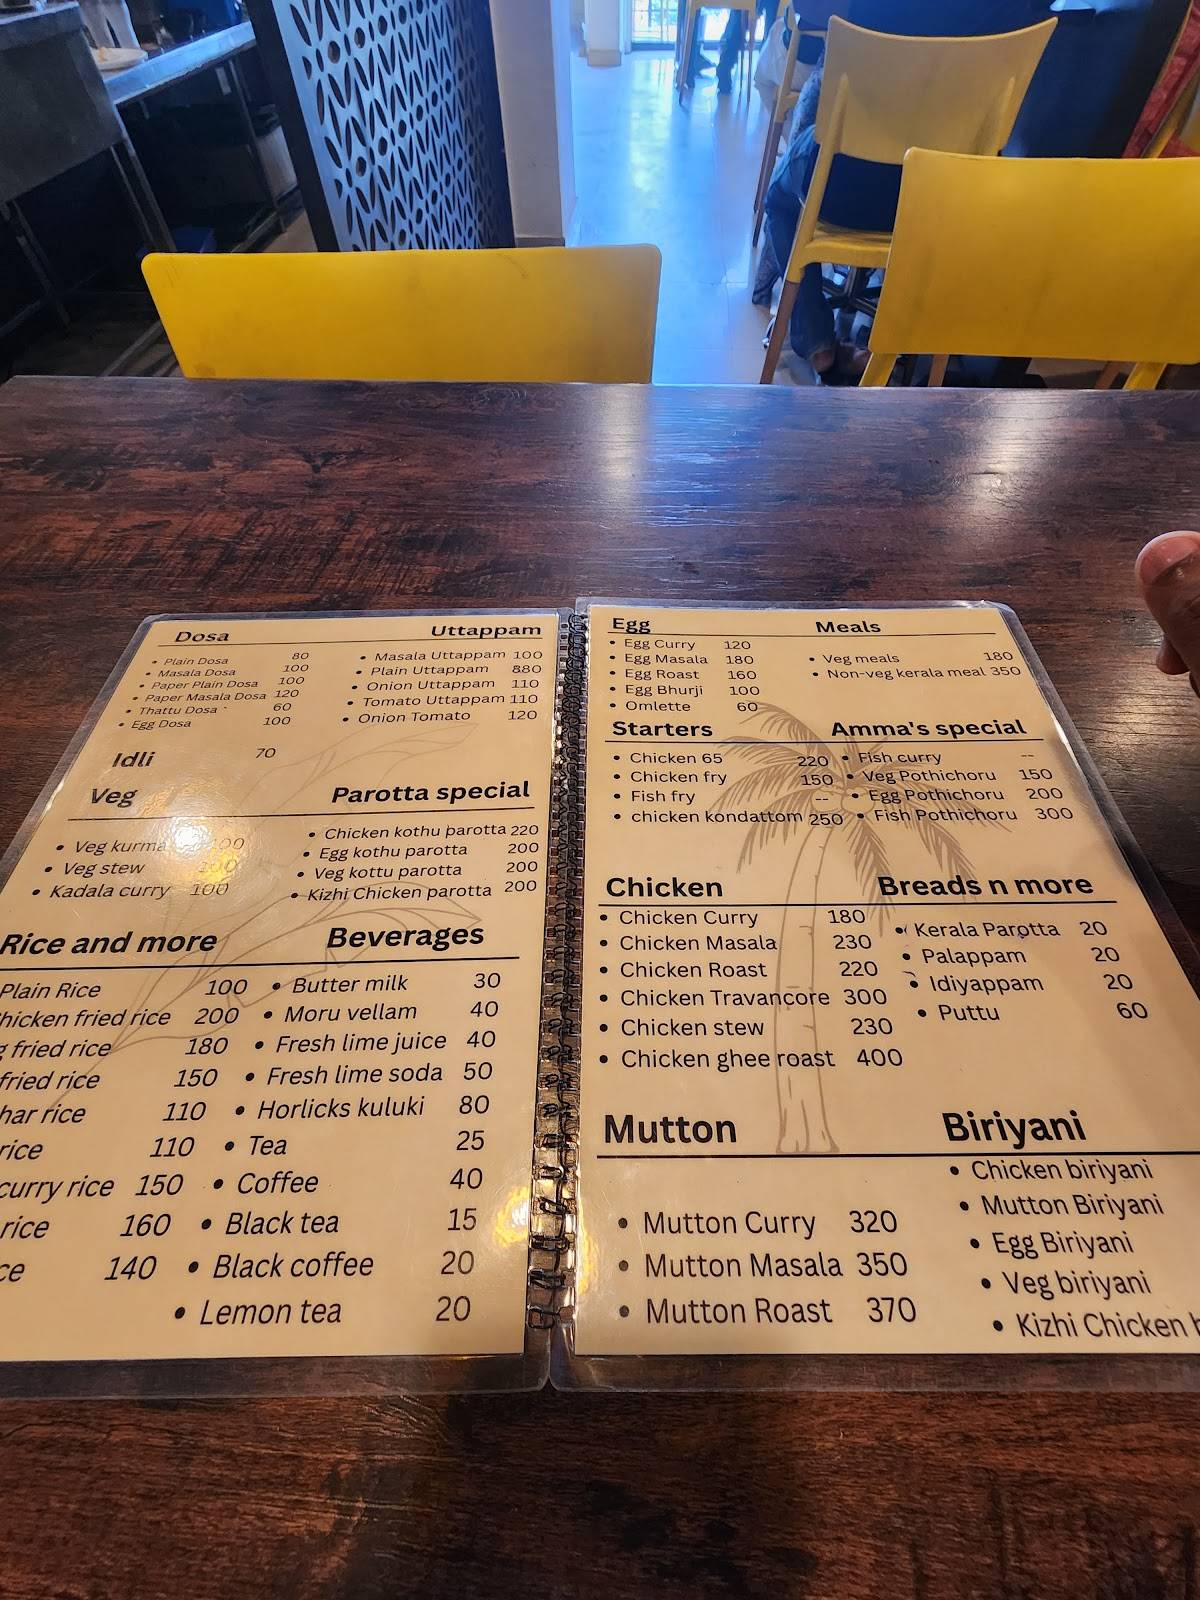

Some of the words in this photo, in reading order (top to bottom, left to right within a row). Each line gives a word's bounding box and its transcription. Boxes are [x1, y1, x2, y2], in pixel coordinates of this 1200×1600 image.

[432, 626, 541, 639] Uttappam
[612, 616, 652, 634] Egg
[816, 621, 881, 633] Meals
[175, 632, 229, 642] Dosa
[654, 640, 695, 651] Curry
[724, 641, 751, 649] 120
[855, 654, 900, 663] meals
[158, 669, 201, 677] Masala
[512, 665, 542, 673] 880
[657, 670, 699, 679] Roast
[728, 670, 756, 680] 160
[827, 670, 894, 680] Non-veg
[896, 668, 944, 678] kerala
[947, 667, 986, 677] meal
[990, 666, 1021, 675] 350
[151, 682, 190, 691] Paper
[367, 682, 412, 691] Onion
[512, 680, 539, 688] 110
[658, 685, 703, 698] Bhurji
[729, 686, 760, 695] 100
[145, 695, 183, 704] Paper
[276, 689, 299, 698] 120
[363, 697, 421, 706] Tomato
[427, 696, 504, 706] Uttappam
[140, 707, 181, 715] Thattu
[273, 703, 291, 711] 60
[626, 701, 690, 711] Omlette
[131, 721, 156, 730] Egg
[158, 720, 191, 728] Dosa
[358, 714, 405, 723] Onion
[414, 712, 470, 722] Tomato
[613, 721, 712, 736] Starters
[832, 722, 930, 736] Amma's
[936, 719, 1027, 739] special
[112, 752, 155, 767] Idli
[256, 748, 276, 758] 70
[702, 753, 722, 764] 65
[897, 754, 941, 765] curry
[704, 771, 727, 785] fry
[899, 770, 996, 781] Pothichoru
[1019, 769, 1052, 780] 150
[92, 788, 138, 808] Veg
[332, 786, 429, 803] Parotta
[436, 781, 530, 804] special
[632, 790, 665, 802] Fish
[671, 790, 695, 805] fry
[1026, 788, 1063, 799] 200
[632, 810, 699, 822] chicken
[705, 810, 802, 823] kondattom
[809, 813, 843, 825] 250
[874, 809, 911, 821] Fish
[915, 808, 1018, 821] Pothichoru
[1035, 808, 1073, 820] 300
[325, 827, 389, 839] Chicken
[394, 826, 440, 837] kothu
[445, 825, 506, 839] parotta
[511, 825, 538, 836] 220
[108, 838, 167, 853] kurma
[353, 846, 400, 858] kothu
[508, 842, 539, 854] 200
[99, 863, 145, 874] stew
[349, 866, 393, 878] kottu
[50, 884, 114, 898] Kadala
[119, 886, 171, 900] curry
[308, 888, 349, 901] Kizhi
[427, 885, 491, 901] parotta
[606, 877, 723, 897] Chicken
[877, 875, 982, 896] Breads
[988, 880, 1008, 895] n
[1014, 879, 1093, 894] more
[828, 910, 865, 923] 180
[327, 927, 484, 951] Beverages
[914, 922, 979, 937] Kerala
[982, 922, 1061, 939] Parotta
[0, 933, 66, 955] Rice
[71, 931, 133, 954] and
[136, 935, 217, 952] more
[833, 935, 871, 949] 230
[922, 948, 1026, 967] Palappam
[839, 961, 878, 976] 220
[0, 983, 51, 999] Plain
[56, 982, 101, 998] Rice
[293, 978, 360, 993] Butter
[365, 975, 408, 991] milk
[474, 973, 500, 988] 30
[930, 975, 1044, 996] Idiyappam
[1103, 974, 1133, 990] 20
[710, 990, 830, 1006] Travancore
[844, 989, 887, 1005] 300
[0, 1011, 69, 1028] hicken
[74, 1009, 127, 1026] fried
[130, 1009, 171, 1026] rice
[284, 1006, 340, 1022] Moru
[348, 1003, 417, 1020] vellam
[470, 1001, 498, 1017] 40
[938, 1004, 1000, 1021] Puttu
[1117, 1002, 1148, 1019] 60
[714, 1020, 764, 1036] stew
[851, 1018, 892, 1035] 230
[185, 1037, 228, 1055] 180
[276, 1034, 335, 1053] Fresh
[343, 1034, 388, 1051] lime
[391, 1032, 446, 1055] juice
[717, 1049, 770, 1073] ghee
[777, 1050, 836, 1067] roast
[857, 1049, 902, 1066] 400
[0, 1071, 55, 1090] fried
[174, 1069, 218, 1087] 150
[267, 1066, 328, 1085] Fresh
[335, 1065, 382, 1084] lime
[389, 1063, 442, 1082] soda
[464, 1062, 492, 1080] 50
[258, 1098, 351, 1119] Horlicks
[358, 1096, 425, 1117] kuluki
[459, 1095, 489, 1114] 80
[605, 1115, 736, 1144] Mutton
[942, 1110, 1086, 1150] Biriyani
[150, 1137, 195, 1157] 110
[250, 1136, 287, 1155] Tea
[456, 1130, 484, 1150] 25
[1065, 1159, 1153, 1184] biriyani
[67, 1175, 114, 1197] rice
[238, 1171, 318, 1194] Coffee
[450, 1168, 482, 1189] 40
[120, 1214, 171, 1236] 160
[225, 1210, 294, 1235] Black
[301, 1213, 338, 1233] tea
[448, 1208, 476, 1231] 15
[745, 1211, 815, 1240] Curry
[849, 1210, 897, 1233] 320
[992, 1232, 1039, 1259] Egg
[1040, 1231, 1134, 1259] Biriyani
[104, 1256, 157, 1280] 140
[213, 1252, 284, 1278] Black
[291, 1251, 373, 1277] coffee
[441, 1250, 474, 1275] 20
[750, 1252, 843, 1277] Masala
[857, 1252, 907, 1276] 350
[1002, 1272, 1054, 1301] Veg
[1055, 1270, 1151, 1300] biriyani
[200, 1300, 291, 1325] Lemon
[301, 1300, 341, 1324] tea
[647, 1298, 746, 1324] Mutton
[755, 1298, 833, 1323] Roast
[867, 1297, 916, 1323] 370
[1016, 1312, 1078, 1337] Kizhi
[1083, 1312, 1188, 1337] Chicken
